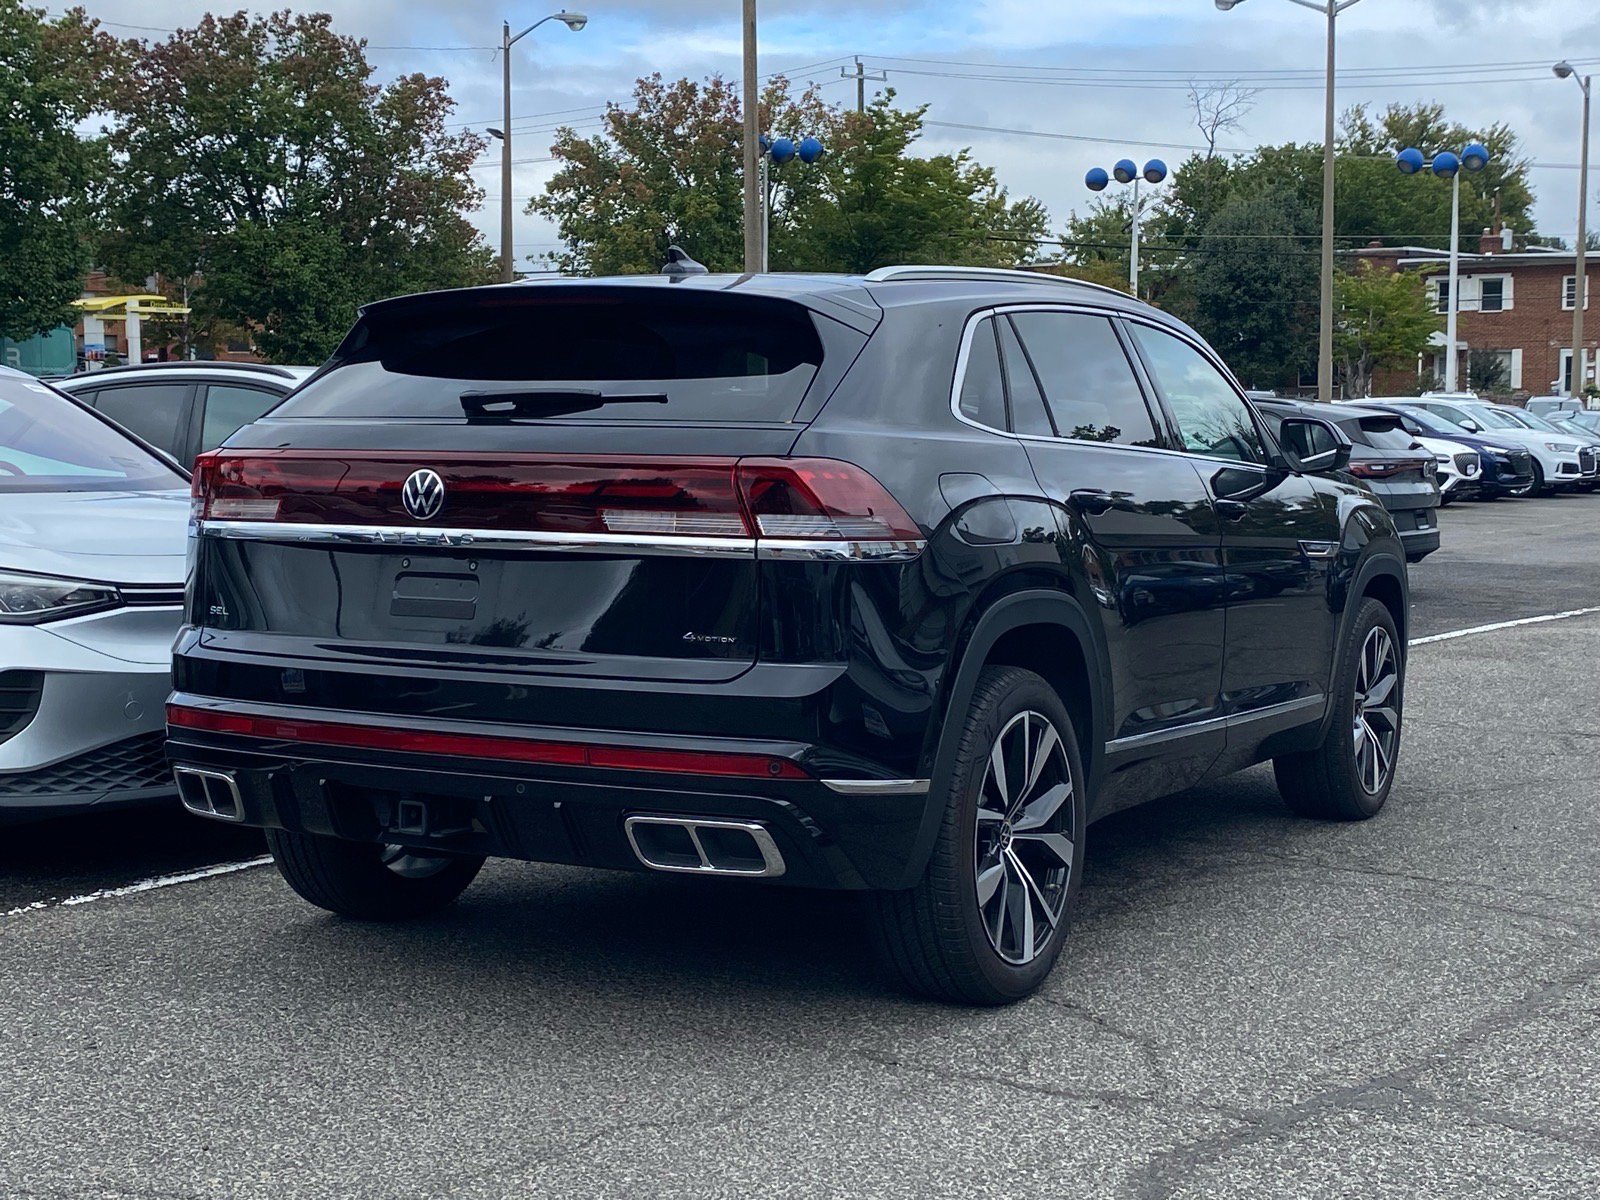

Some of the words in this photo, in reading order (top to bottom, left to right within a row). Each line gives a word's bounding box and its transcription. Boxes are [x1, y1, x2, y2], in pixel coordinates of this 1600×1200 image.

[373, 531, 474, 545] ATLAS
[209, 605, 229, 615] SEL
[682, 631, 737, 643] 4MOTION
